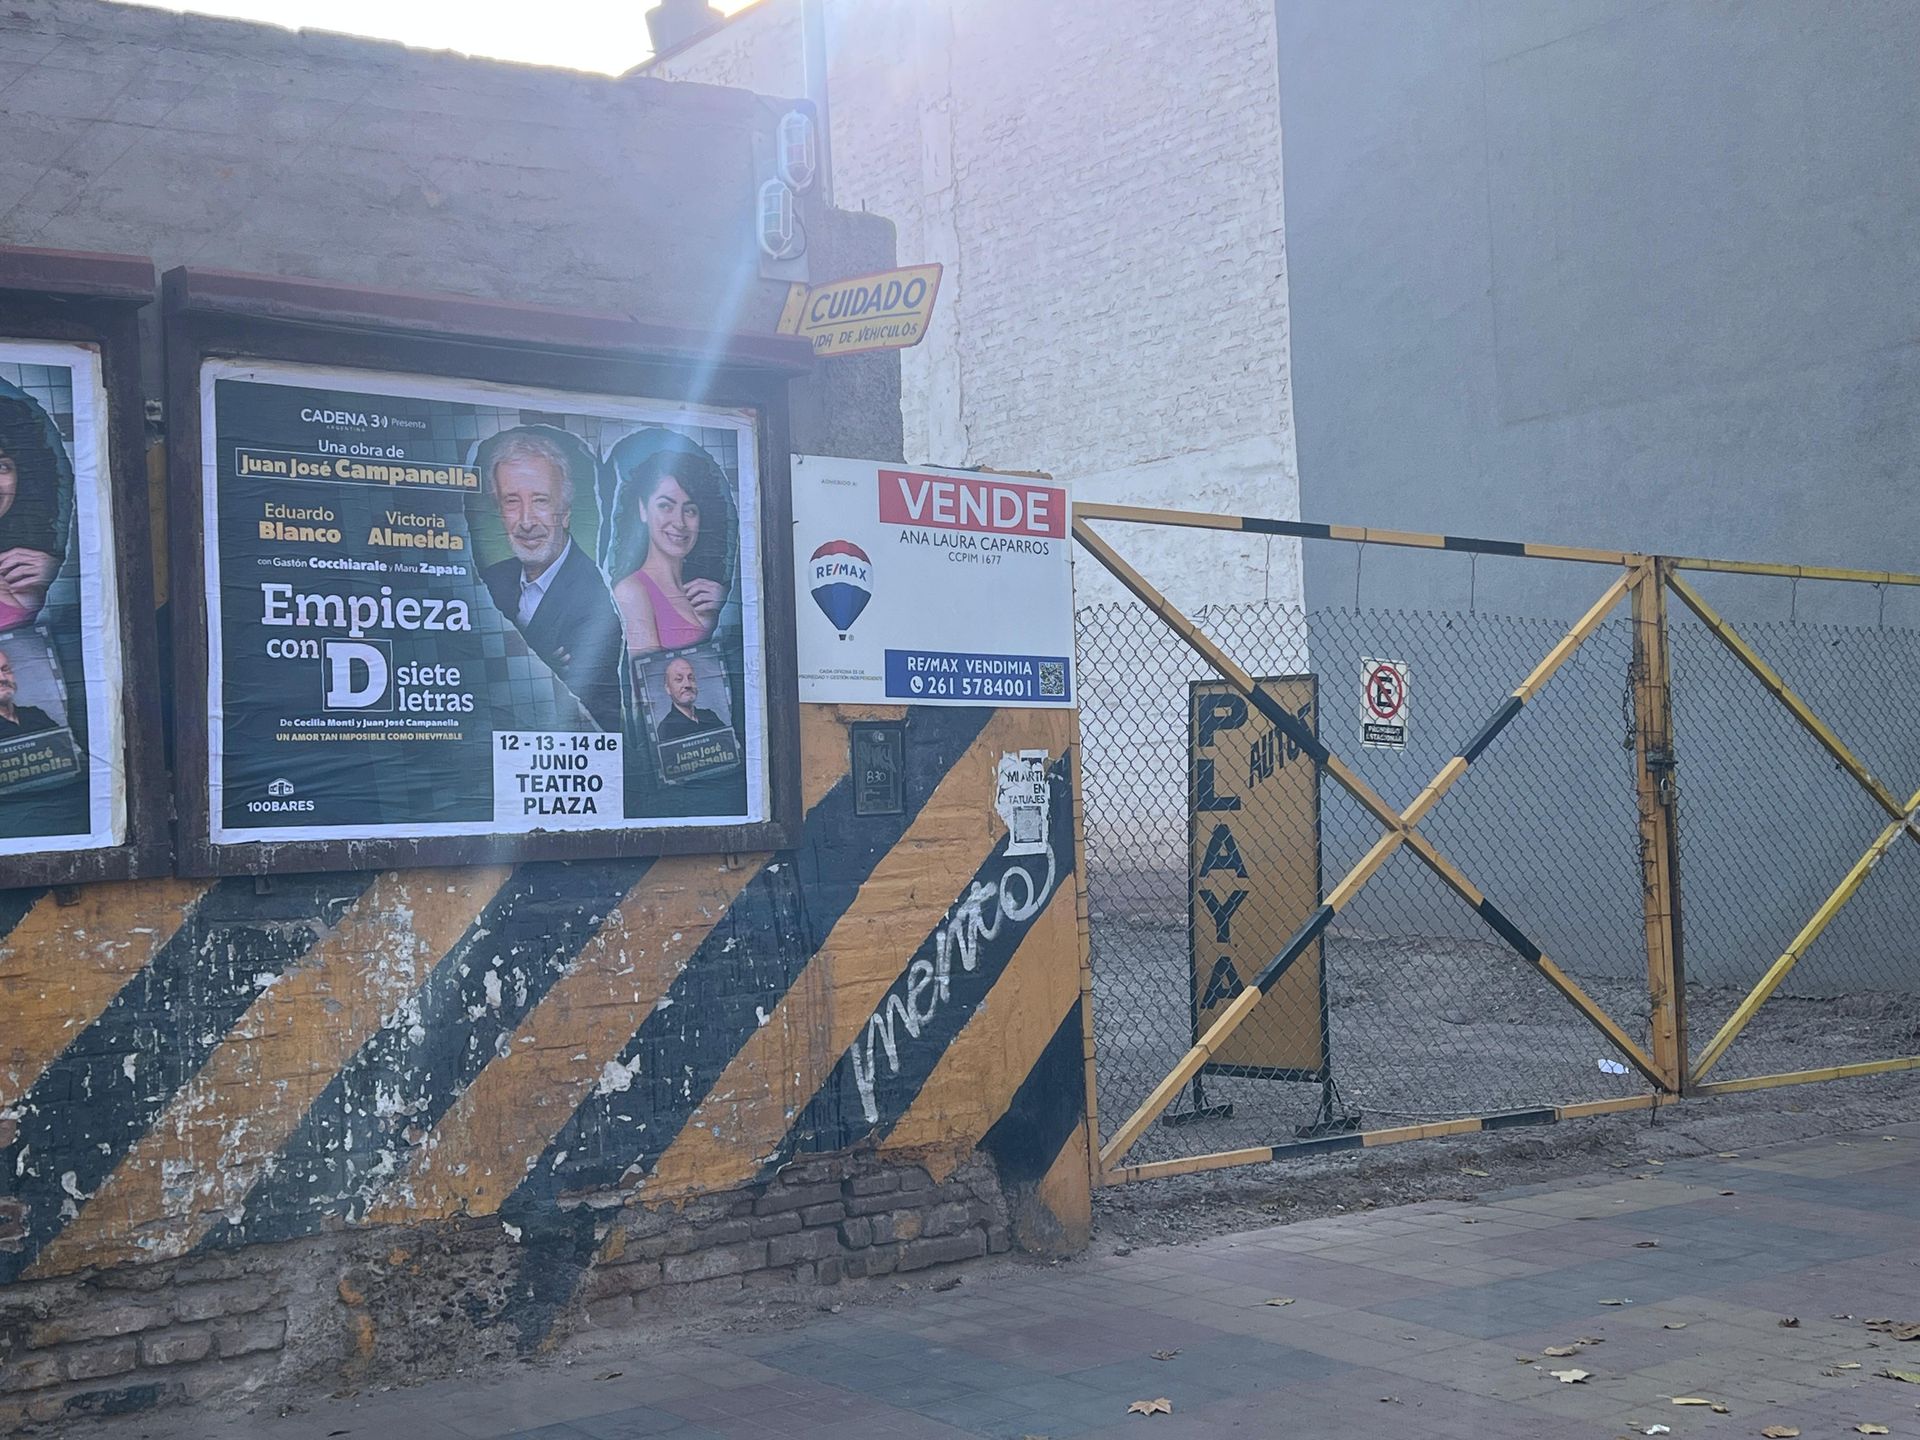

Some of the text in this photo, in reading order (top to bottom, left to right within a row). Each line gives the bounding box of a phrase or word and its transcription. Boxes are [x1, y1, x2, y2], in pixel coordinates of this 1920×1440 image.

[811, 277, 927, 322] CUIDADO
[839, 330, 855, 344] DE
[857, 321, 918, 343] VEHICULOS
[301, 408, 368, 427] CADENA
[391, 418, 426, 429] Presenta
[318, 440, 405, 458] Una obra de
[240, 454, 477, 487] Juan José Campanella
[264, 503, 335, 522] Eduardo
[898, 477, 1050, 532] VENDE
[385, 510, 446, 529] Victoria
[258, 520, 342, 544] Blanco
[367, 528, 464, 550] Almeida
[900, 530, 1049, 556] ANA LAURA CAPARROS
[257, 558, 272, 566] con
[272, 557, 308, 568] Gastón
[309, 557, 387, 572] Cocchiarale
[394, 563, 418, 574] Maru
[419, 562, 467, 577] Zapata
[948, 551, 1001, 565] CCPIM 1677
[816, 562, 867, 582] RE/MAX
[261, 582, 472, 638] Empieza
[266, 638, 388, 708] con D
[397, 661, 461, 687] siete
[907, 656, 1033, 675] RE/MAX VENDIMIA
[927, 677, 1032, 696] 261 5784001
[398, 687, 475, 712] letras
[280, 719, 293, 727] De
[293, 718, 326, 727] Cecilia
[327, 718, 355, 727] Monti
[362, 719, 385, 728] Juan
[385, 718, 405, 728] José
[406, 718, 459, 728] Campanella
[276, 733, 290, 741] UN
[291, 733, 319, 741] AMOR
[320, 733, 338, 741] TAN
[339, 733, 386, 741] IMPOSIBLE
[415, 732, 463, 740] INEVITABLE
[500, 735, 519, 750] 12
[536, 735, 554, 751] 13
[571, 736, 590, 751] 14
[594, 735, 617, 750] de
[22, 746, 53, 766] José
[530, 754, 588, 770] JUNIO
[666, 751, 735, 775] Campanella
[676, 742, 722, 764] Juan José
[515, 774, 603, 792] TEATRO
[1033, 783, 1046, 794] EN
[247, 800, 314, 812] 100BARES
[523, 797, 597, 814] PLAZA
[1008, 794, 1046, 804] TATUAJES
[1198, 692, 1250, 1010] PLAYA
